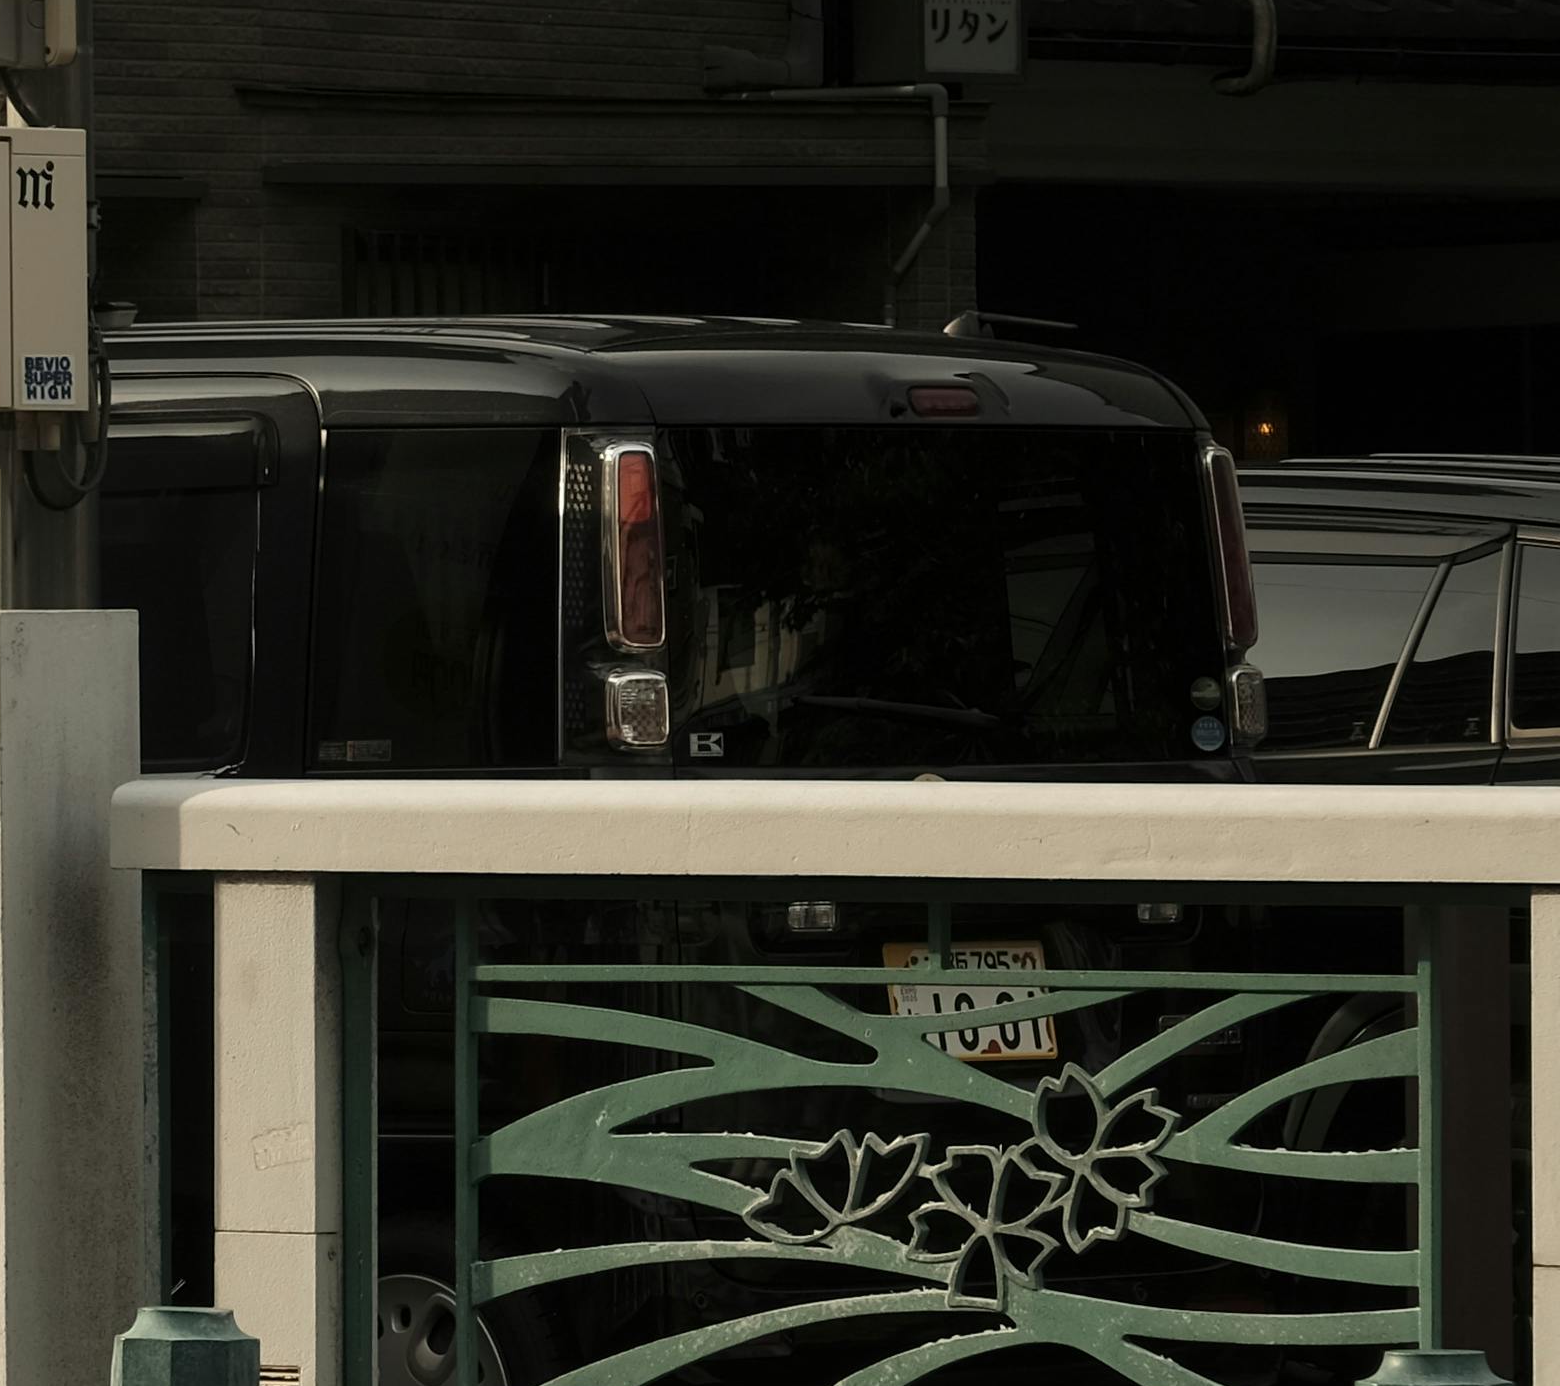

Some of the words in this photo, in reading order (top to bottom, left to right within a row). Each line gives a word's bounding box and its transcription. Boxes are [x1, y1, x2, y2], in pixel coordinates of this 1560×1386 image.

[930, 8, 1009, 44] リタン
[25, 371, 73, 386] SUPER
[26, 386, 72, 400] HIGH
